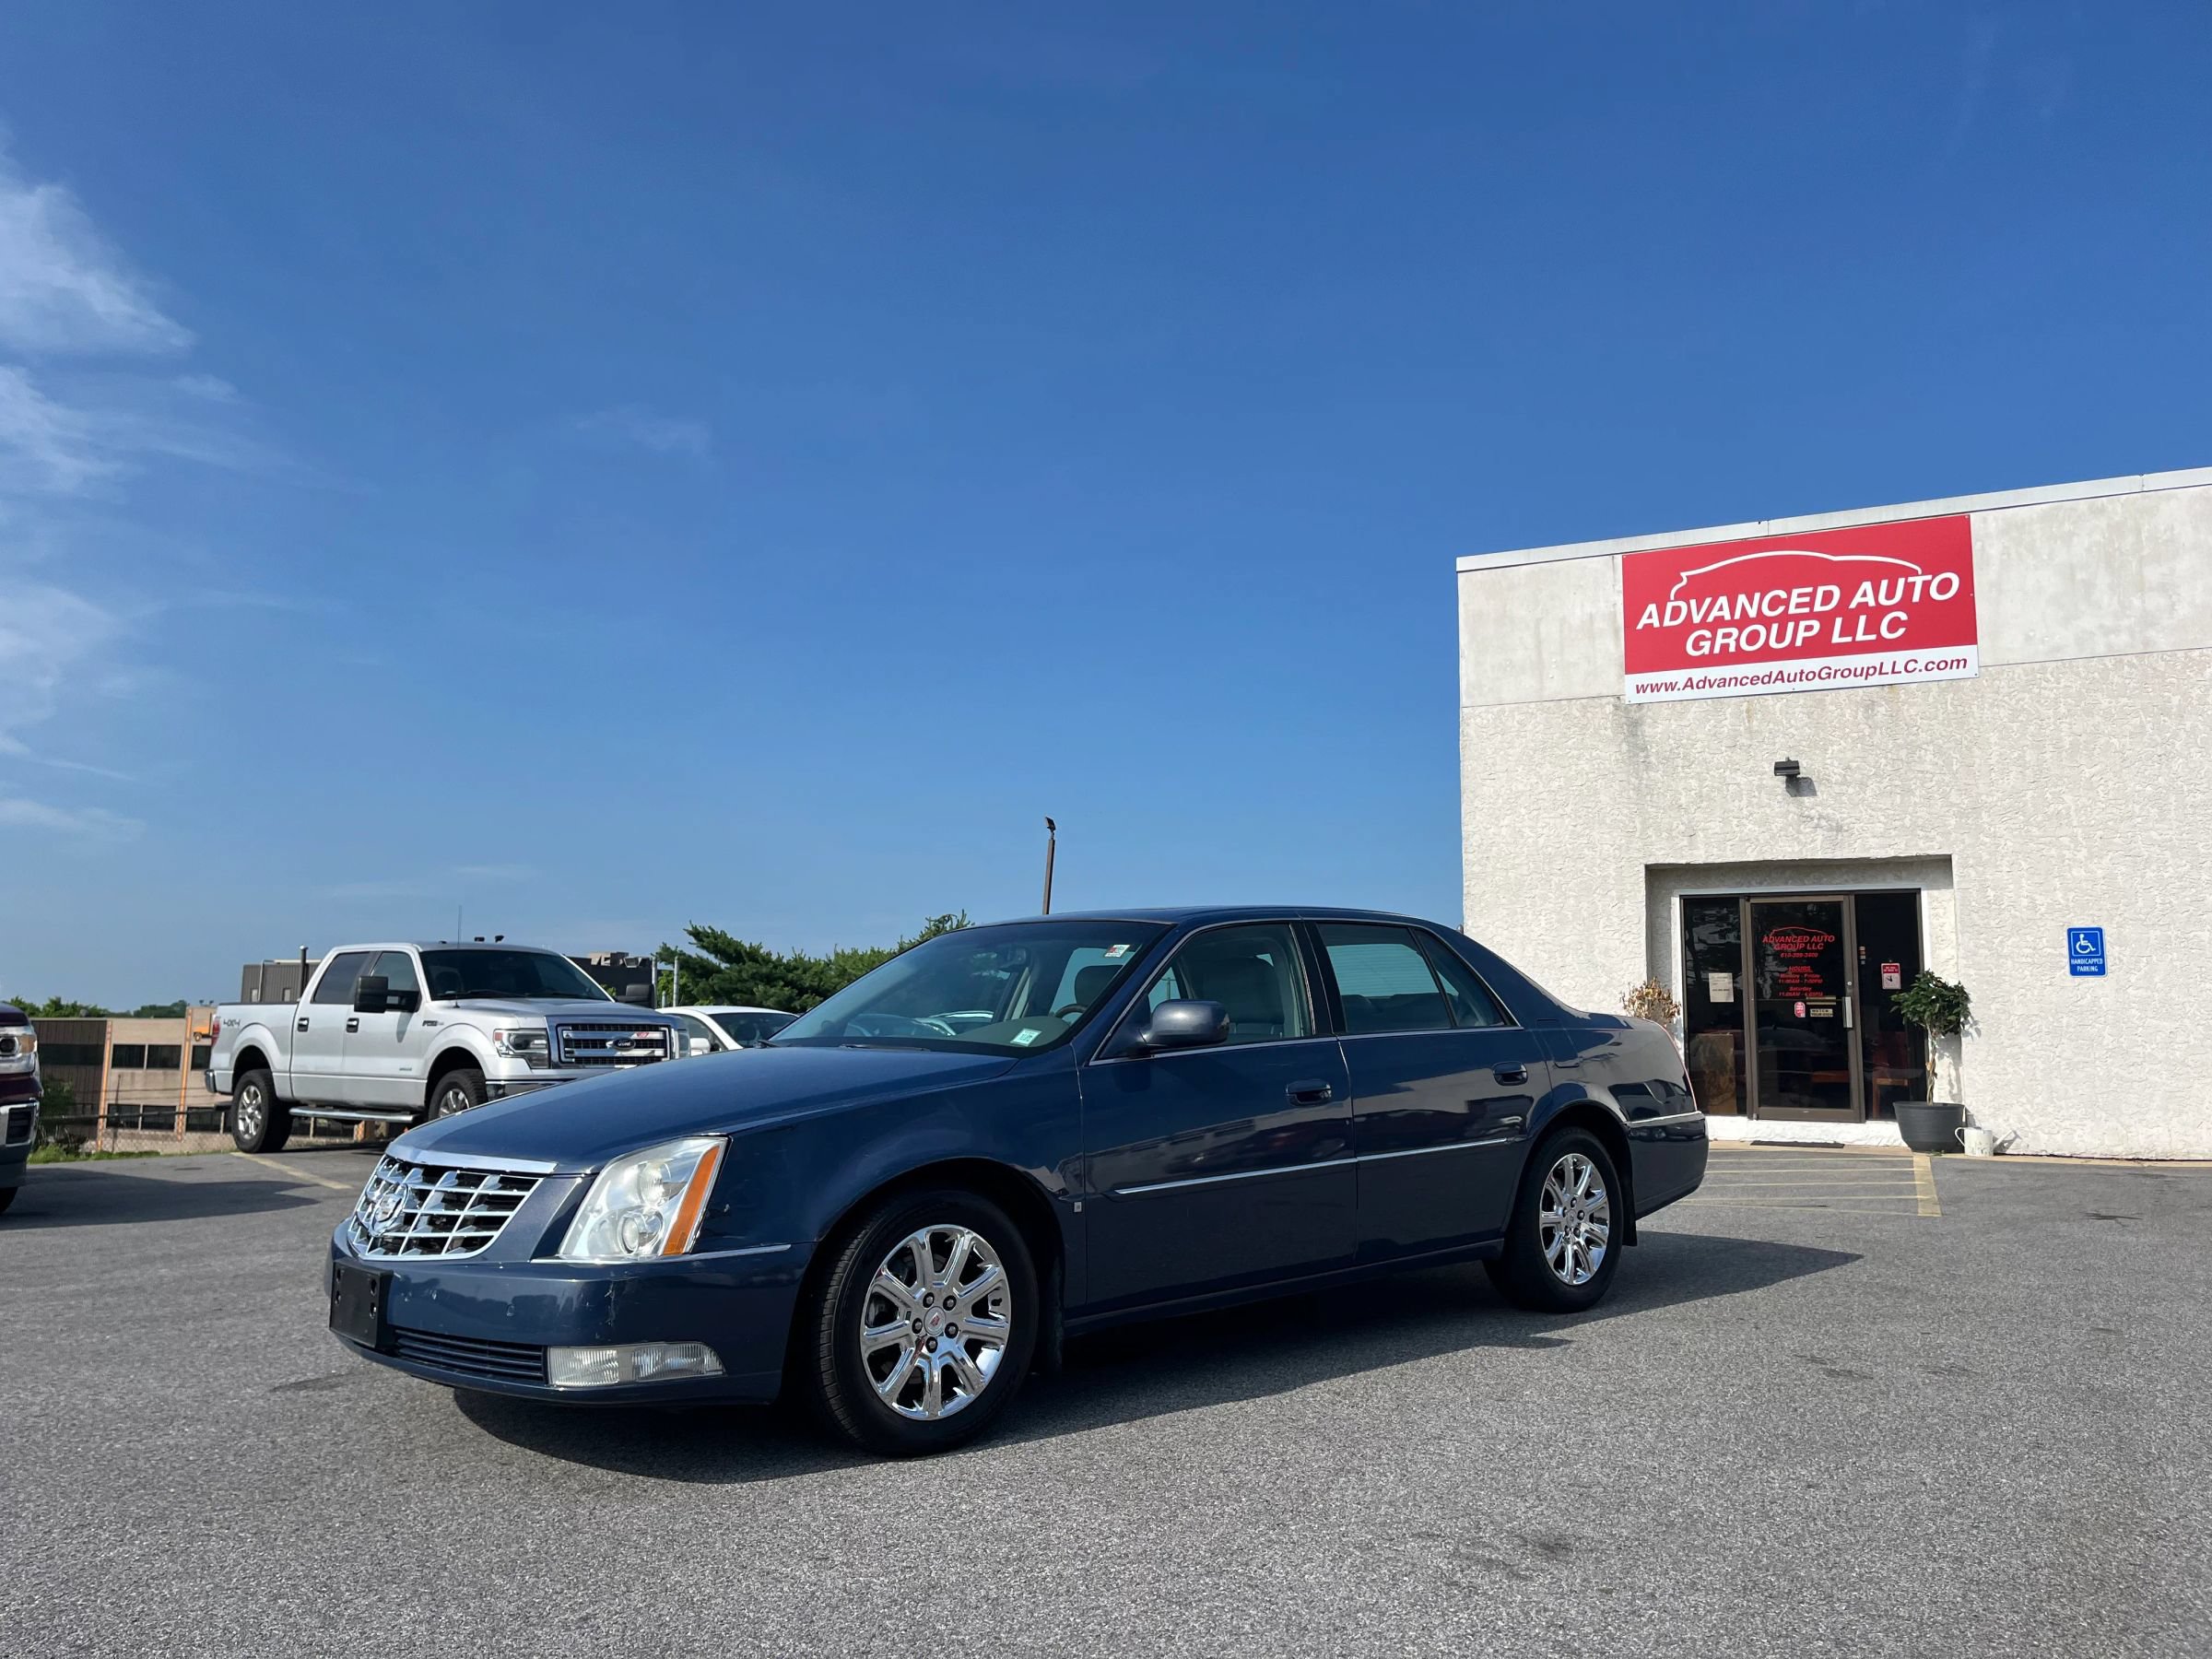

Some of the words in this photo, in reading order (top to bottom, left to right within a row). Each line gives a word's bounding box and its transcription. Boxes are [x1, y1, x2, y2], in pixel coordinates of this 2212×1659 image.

[1636, 584, 1841, 630] ADVANCED
[1848, 571, 1960, 609] AUTO
[1686, 619, 1821, 656] GROUP
[1831, 611, 1908, 643] LLC
[1635, 657, 1968, 695] www.AdvancedAutoGroupLLC.com
